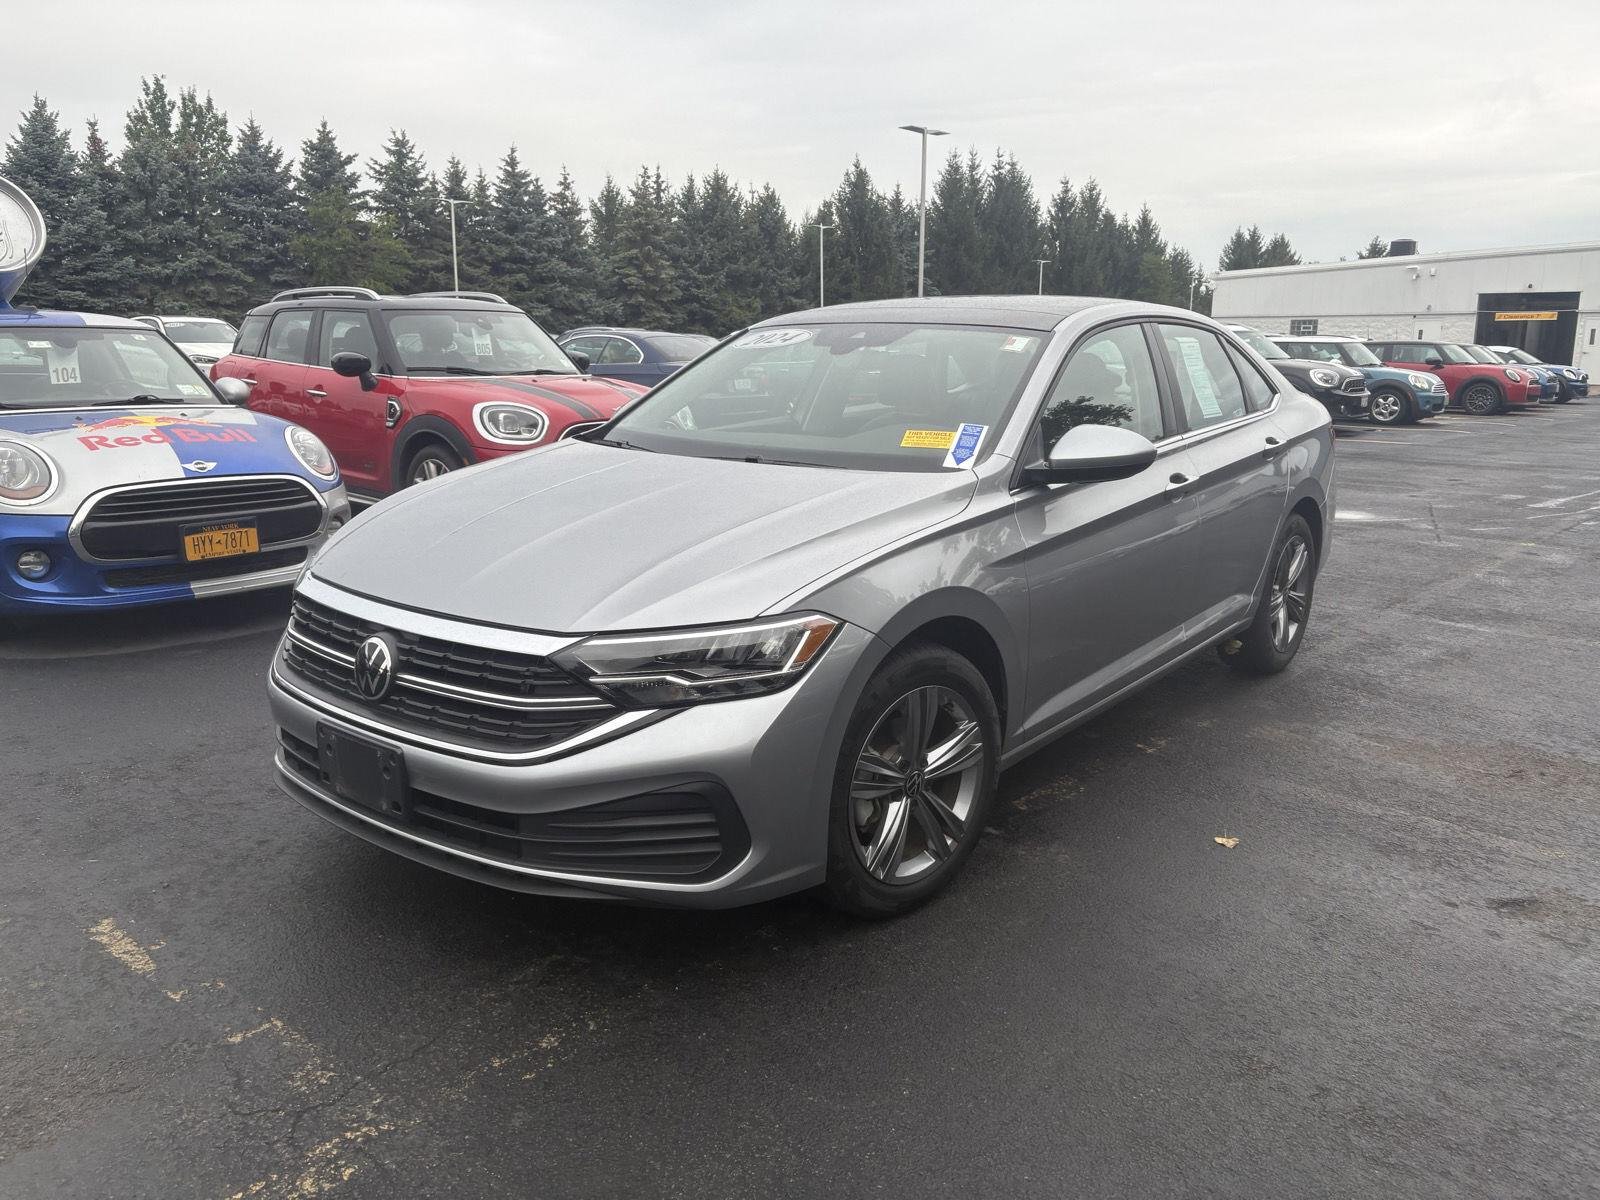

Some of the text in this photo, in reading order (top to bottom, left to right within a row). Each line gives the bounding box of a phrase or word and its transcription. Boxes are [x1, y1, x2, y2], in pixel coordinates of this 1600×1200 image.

[52, 367, 78, 382] 104
[77, 427, 257, 451] Red Bull
[192, 530, 250, 554] HYY 7871
